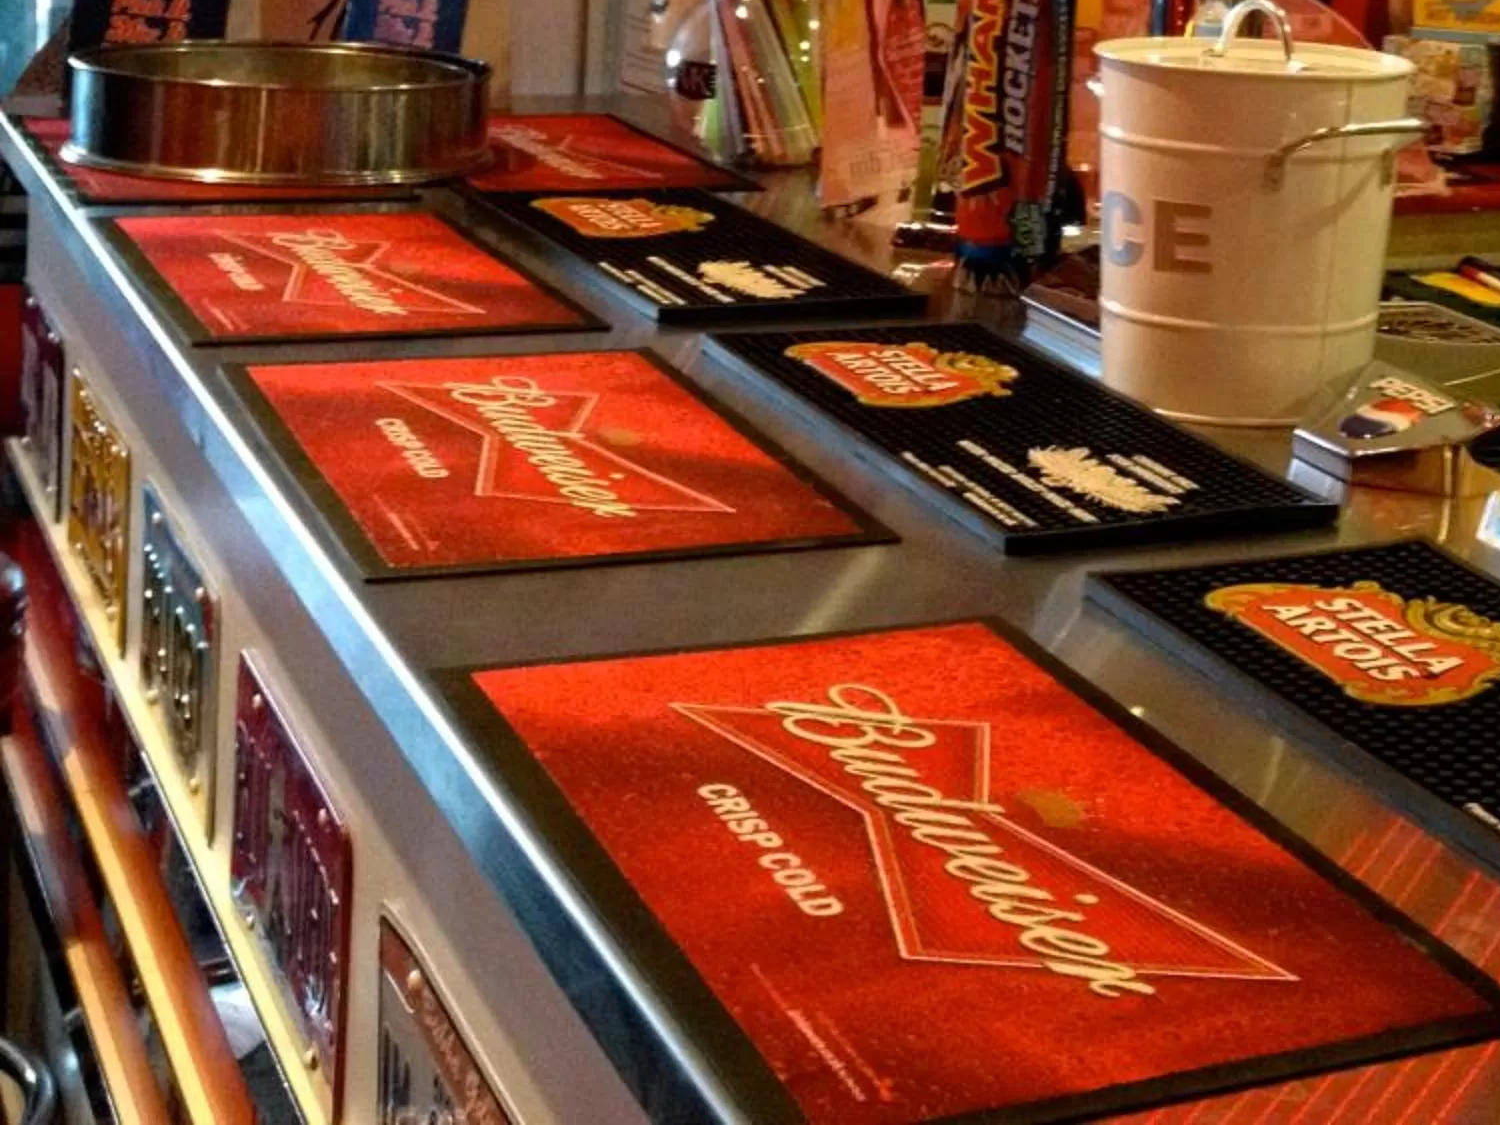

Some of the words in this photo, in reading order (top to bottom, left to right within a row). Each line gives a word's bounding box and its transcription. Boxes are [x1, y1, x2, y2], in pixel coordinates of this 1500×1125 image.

[1002, 0, 1040, 155] ROCKET
[1102, 191, 1213, 275] CE
[826, 351, 923, 394] ARTOIS
[868, 348, 960, 392] STELLA
[1369, 376, 1458, 416] PEPSI
[441, 375, 639, 518] Budweiser
[1260, 602, 1418, 685] ARTOIS
[1314, 596, 1466, 677] STELLA
[696, 782, 786, 851] CRISP
[758, 849, 845, 918] COLD
[763, 681, 1156, 1002] Budweiser
